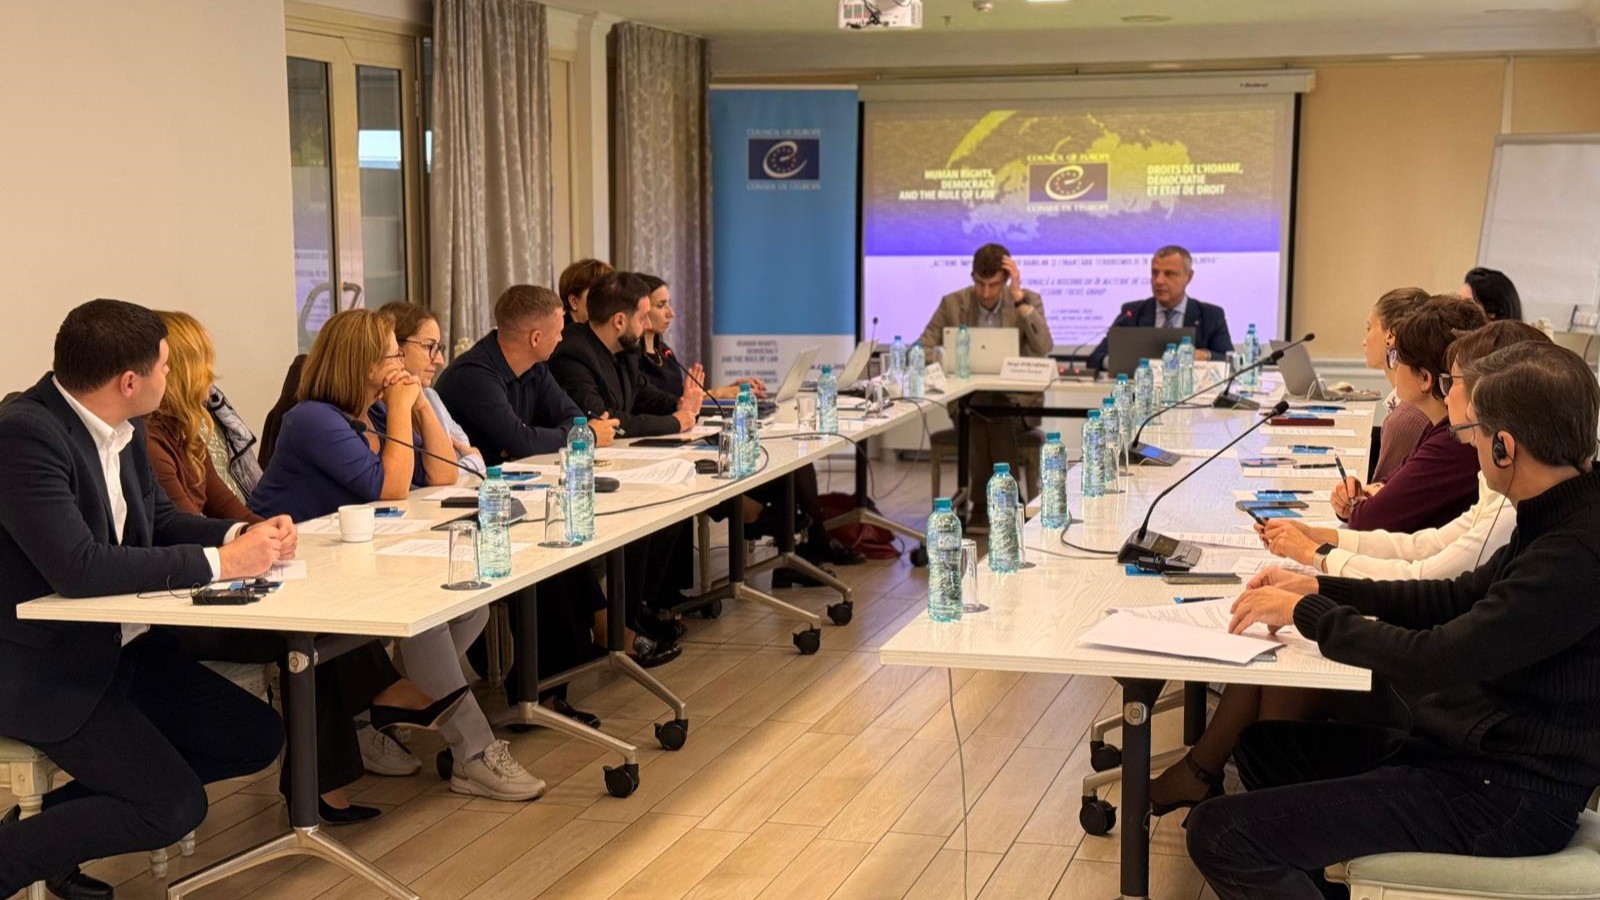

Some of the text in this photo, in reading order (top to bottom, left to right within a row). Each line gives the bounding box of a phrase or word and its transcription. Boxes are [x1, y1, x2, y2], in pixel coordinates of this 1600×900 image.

[924, 169, 959, 180] HUMAN
[1147, 164, 1181, 175] DROITS
[1183, 164, 1195, 174] DE
[941, 179, 995, 190] DEMOCRACY
[899, 189, 995, 200] AND THE RULE OF LAW
[1147, 186, 1158, 197] ET
[1183, 185, 1195, 196] DE
[1197, 184, 1226, 195] DROIT
